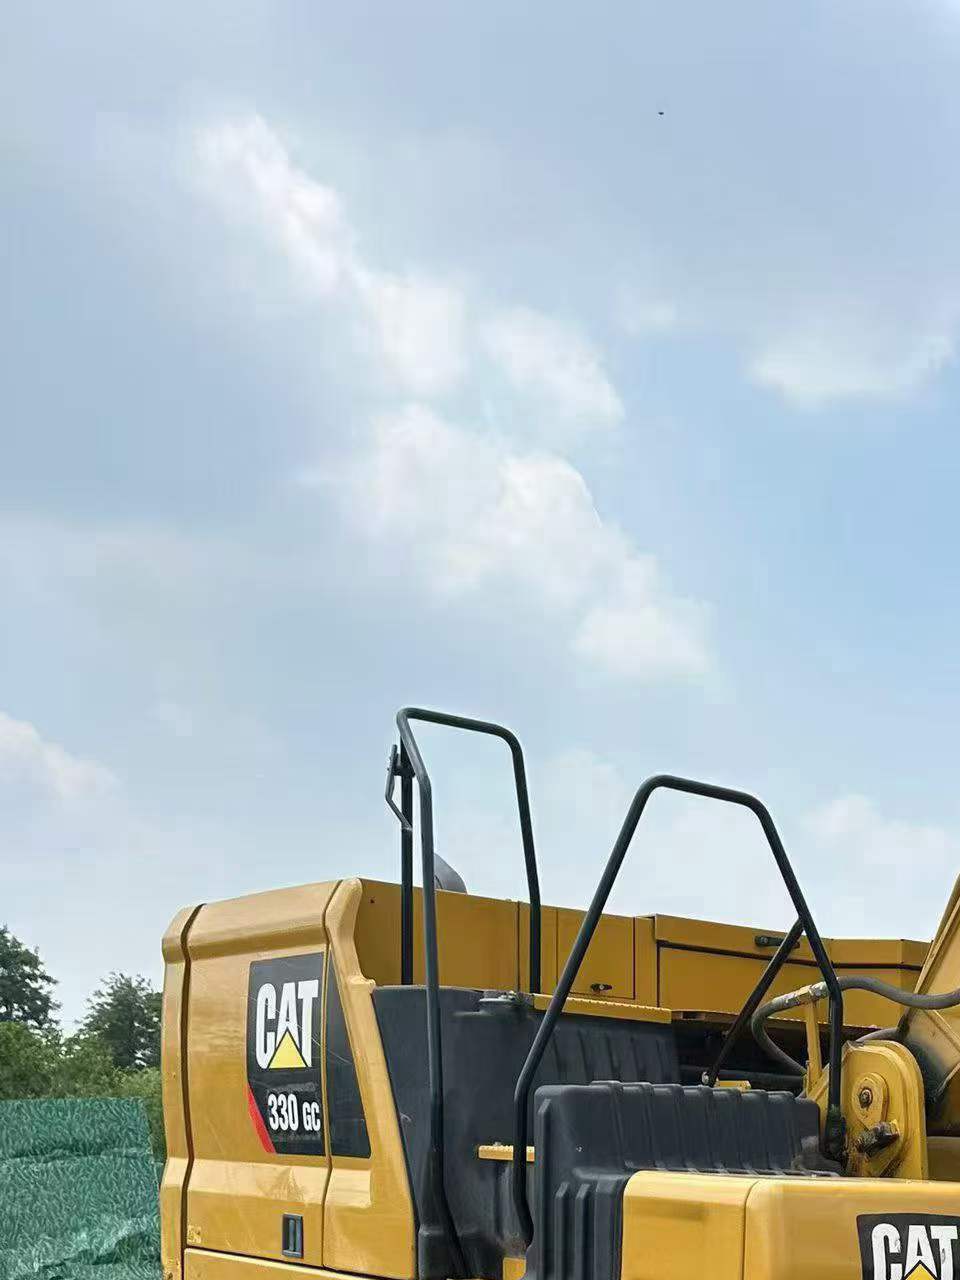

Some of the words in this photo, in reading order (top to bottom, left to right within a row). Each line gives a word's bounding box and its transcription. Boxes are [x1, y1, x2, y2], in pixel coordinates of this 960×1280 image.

[255, 979, 319, 1069] CAT
[267, 1093, 299, 1132] 330
[302, 1101, 321, 1132] GC
